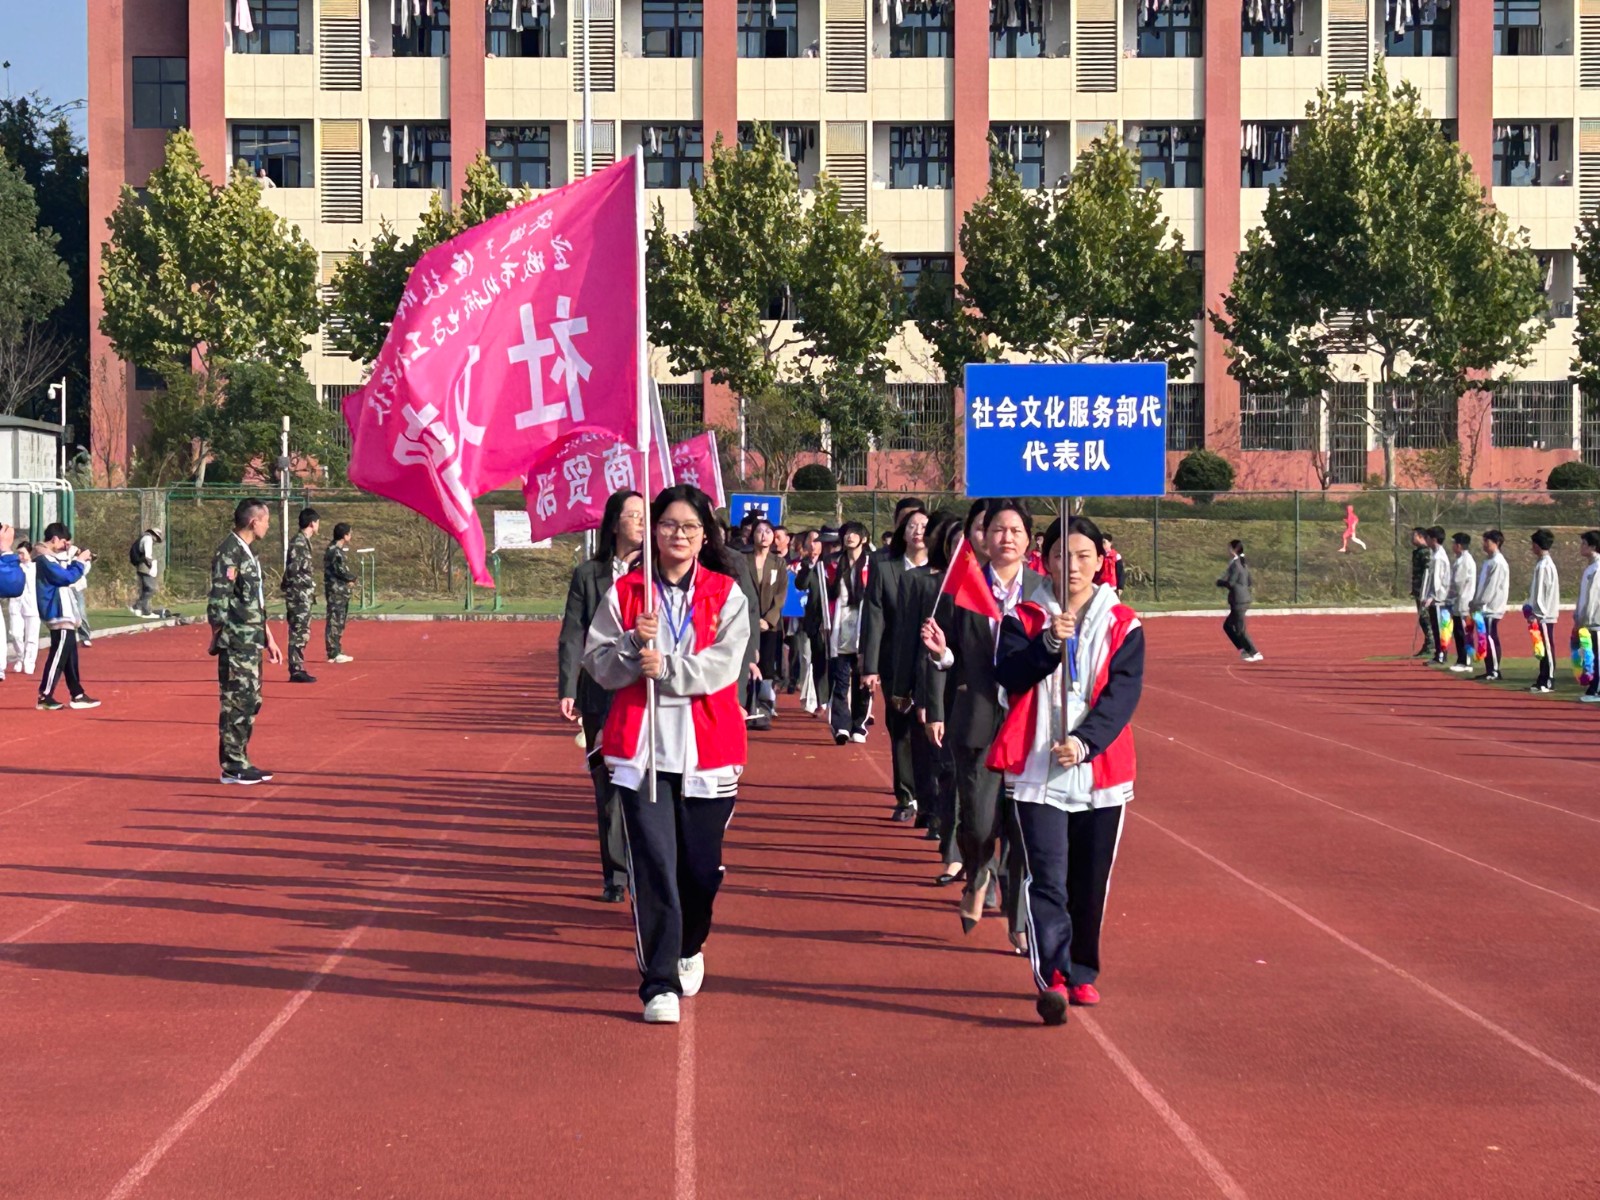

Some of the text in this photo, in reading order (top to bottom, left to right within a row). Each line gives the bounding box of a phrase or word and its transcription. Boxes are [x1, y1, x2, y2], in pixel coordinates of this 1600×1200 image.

[971, 394, 1162, 429] 社会文化服务部代
[1022, 439, 1111, 471] 代表队
